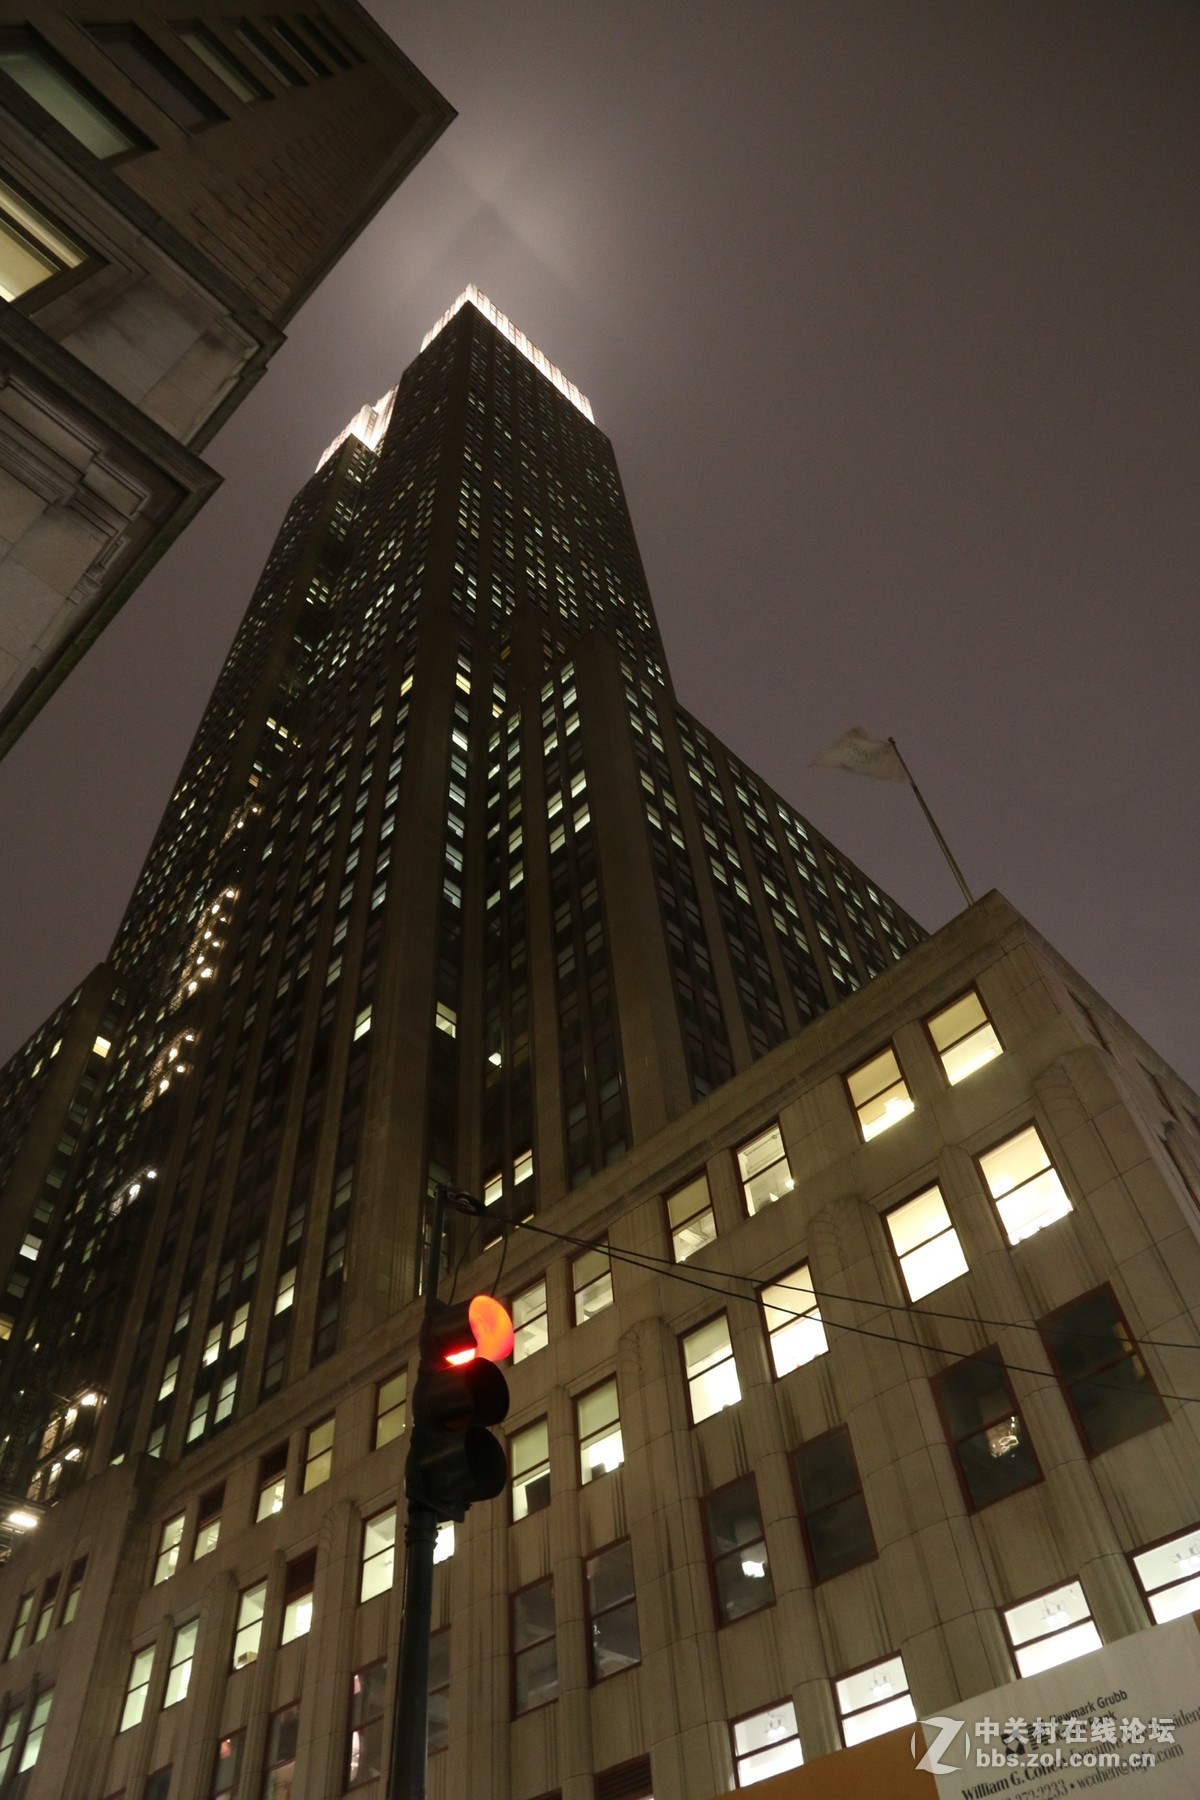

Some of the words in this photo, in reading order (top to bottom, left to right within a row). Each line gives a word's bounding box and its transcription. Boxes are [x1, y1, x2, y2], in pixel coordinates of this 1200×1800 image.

[1097, 1689, 1128, 1709] Grubb
[962, 1778, 1010, 1800] William
[1010, 1771, 1025, 1786] G.
